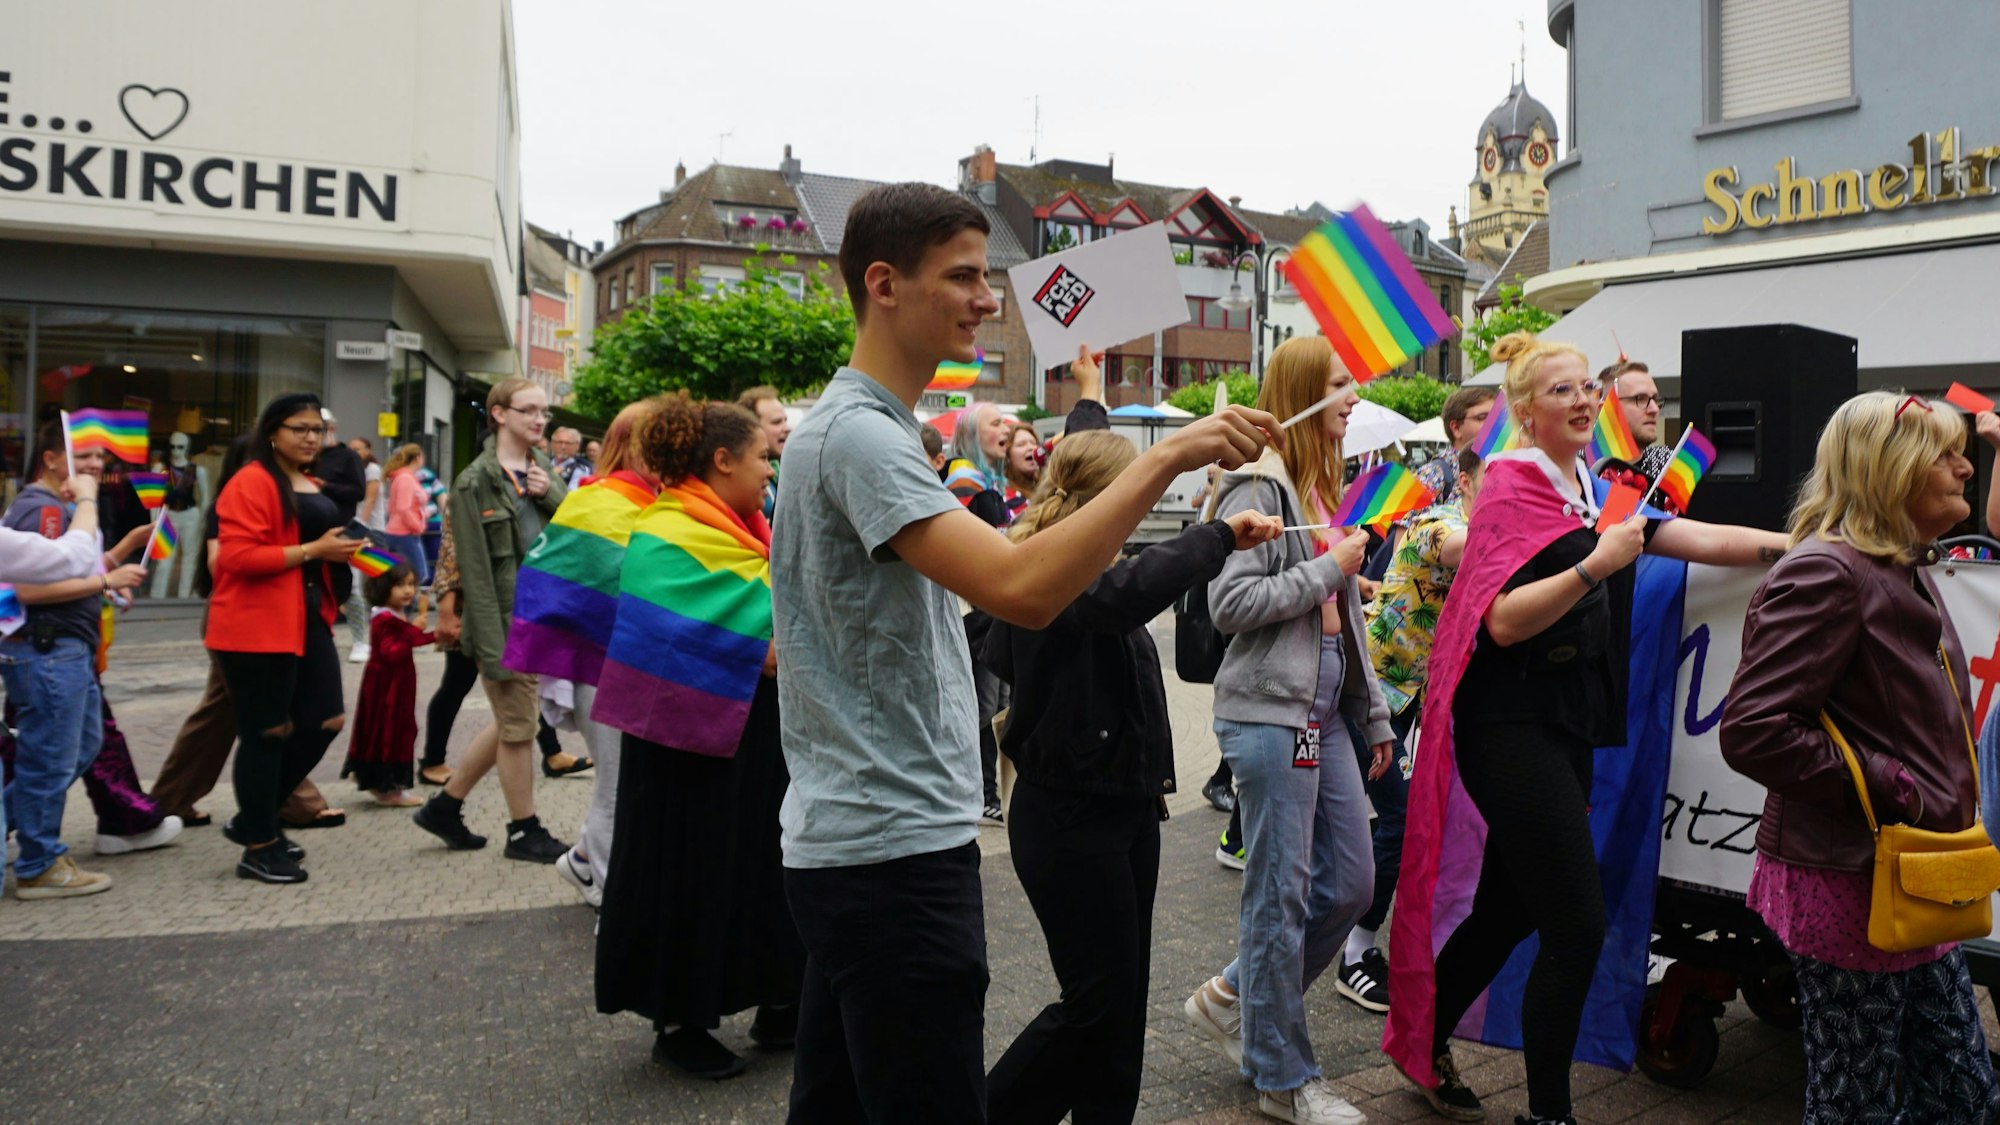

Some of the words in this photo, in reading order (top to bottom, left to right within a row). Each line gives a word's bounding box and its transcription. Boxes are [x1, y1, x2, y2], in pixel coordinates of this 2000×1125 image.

[0, 138, 397, 222] SKIRCHEN
[1040, 270, 1077, 311] FCK
[1055, 281, 1087, 321] AFD
